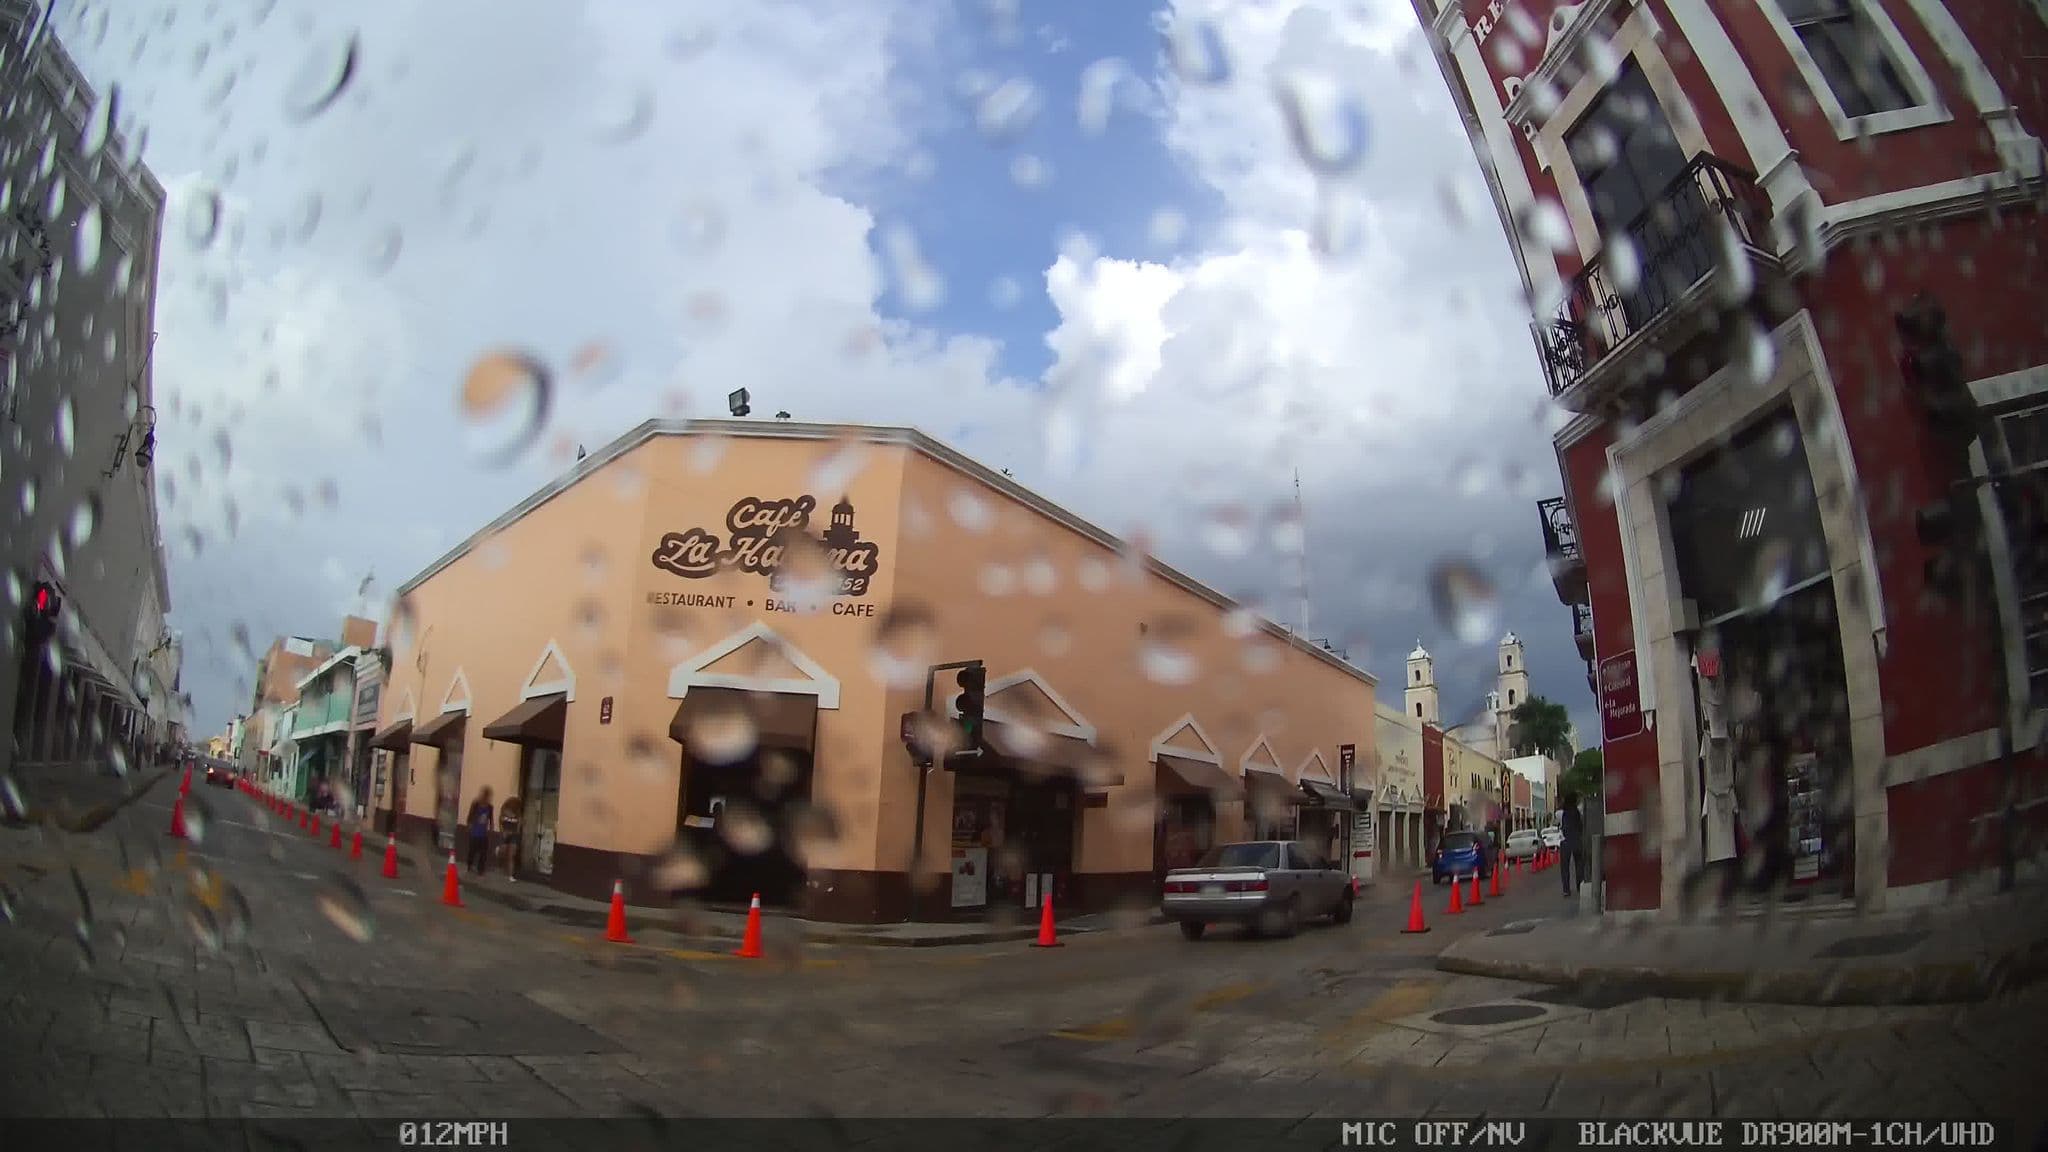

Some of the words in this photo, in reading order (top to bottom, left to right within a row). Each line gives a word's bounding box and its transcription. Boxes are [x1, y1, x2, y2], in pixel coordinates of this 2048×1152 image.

[733, 501, 808, 536] Café
[659, 535, 715, 571] La
[721, 536, 869, 571] Hana
[832, 602, 874, 617] CAFE
